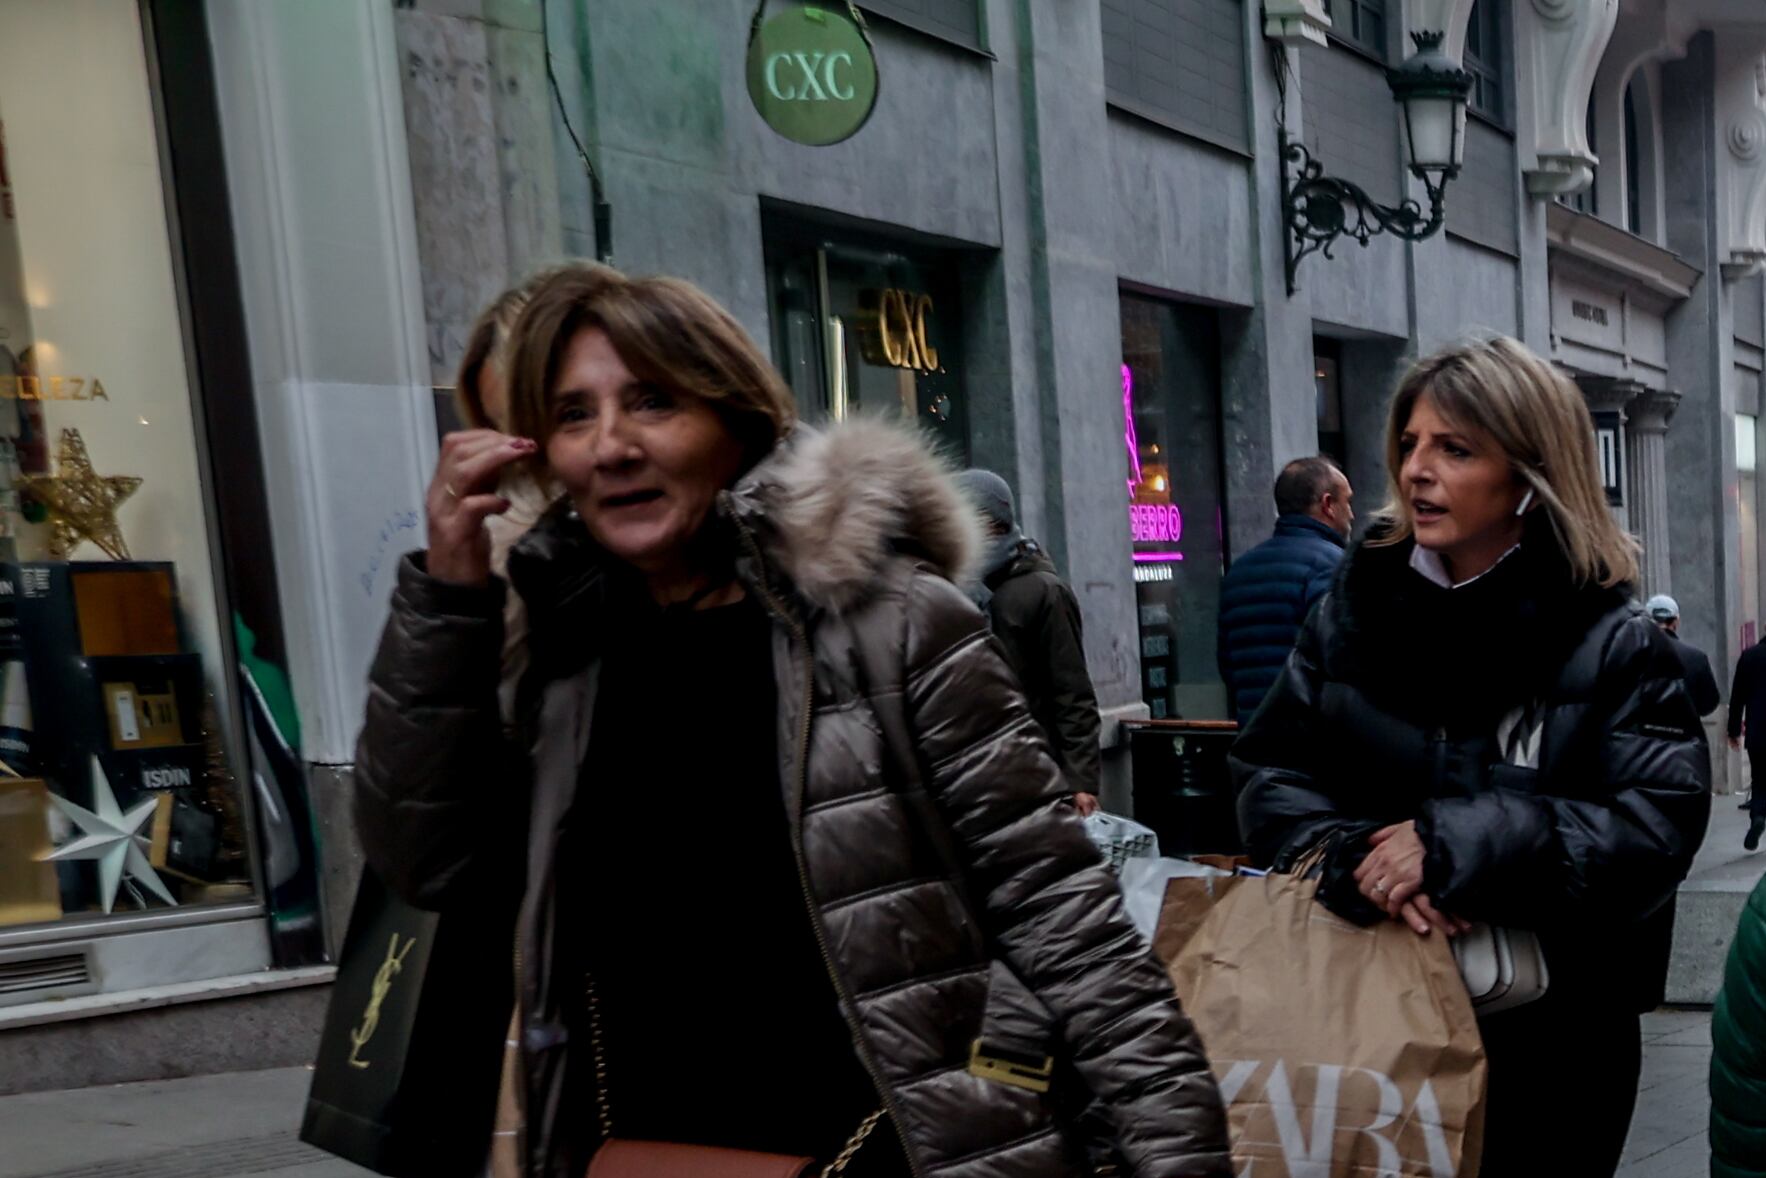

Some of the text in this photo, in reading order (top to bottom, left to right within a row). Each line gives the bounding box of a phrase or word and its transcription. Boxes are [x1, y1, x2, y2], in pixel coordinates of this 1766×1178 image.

[765, 51, 855, 101] CXC
[880, 288, 939, 371] CXC
[141, 765, 192, 789] ISDIN
